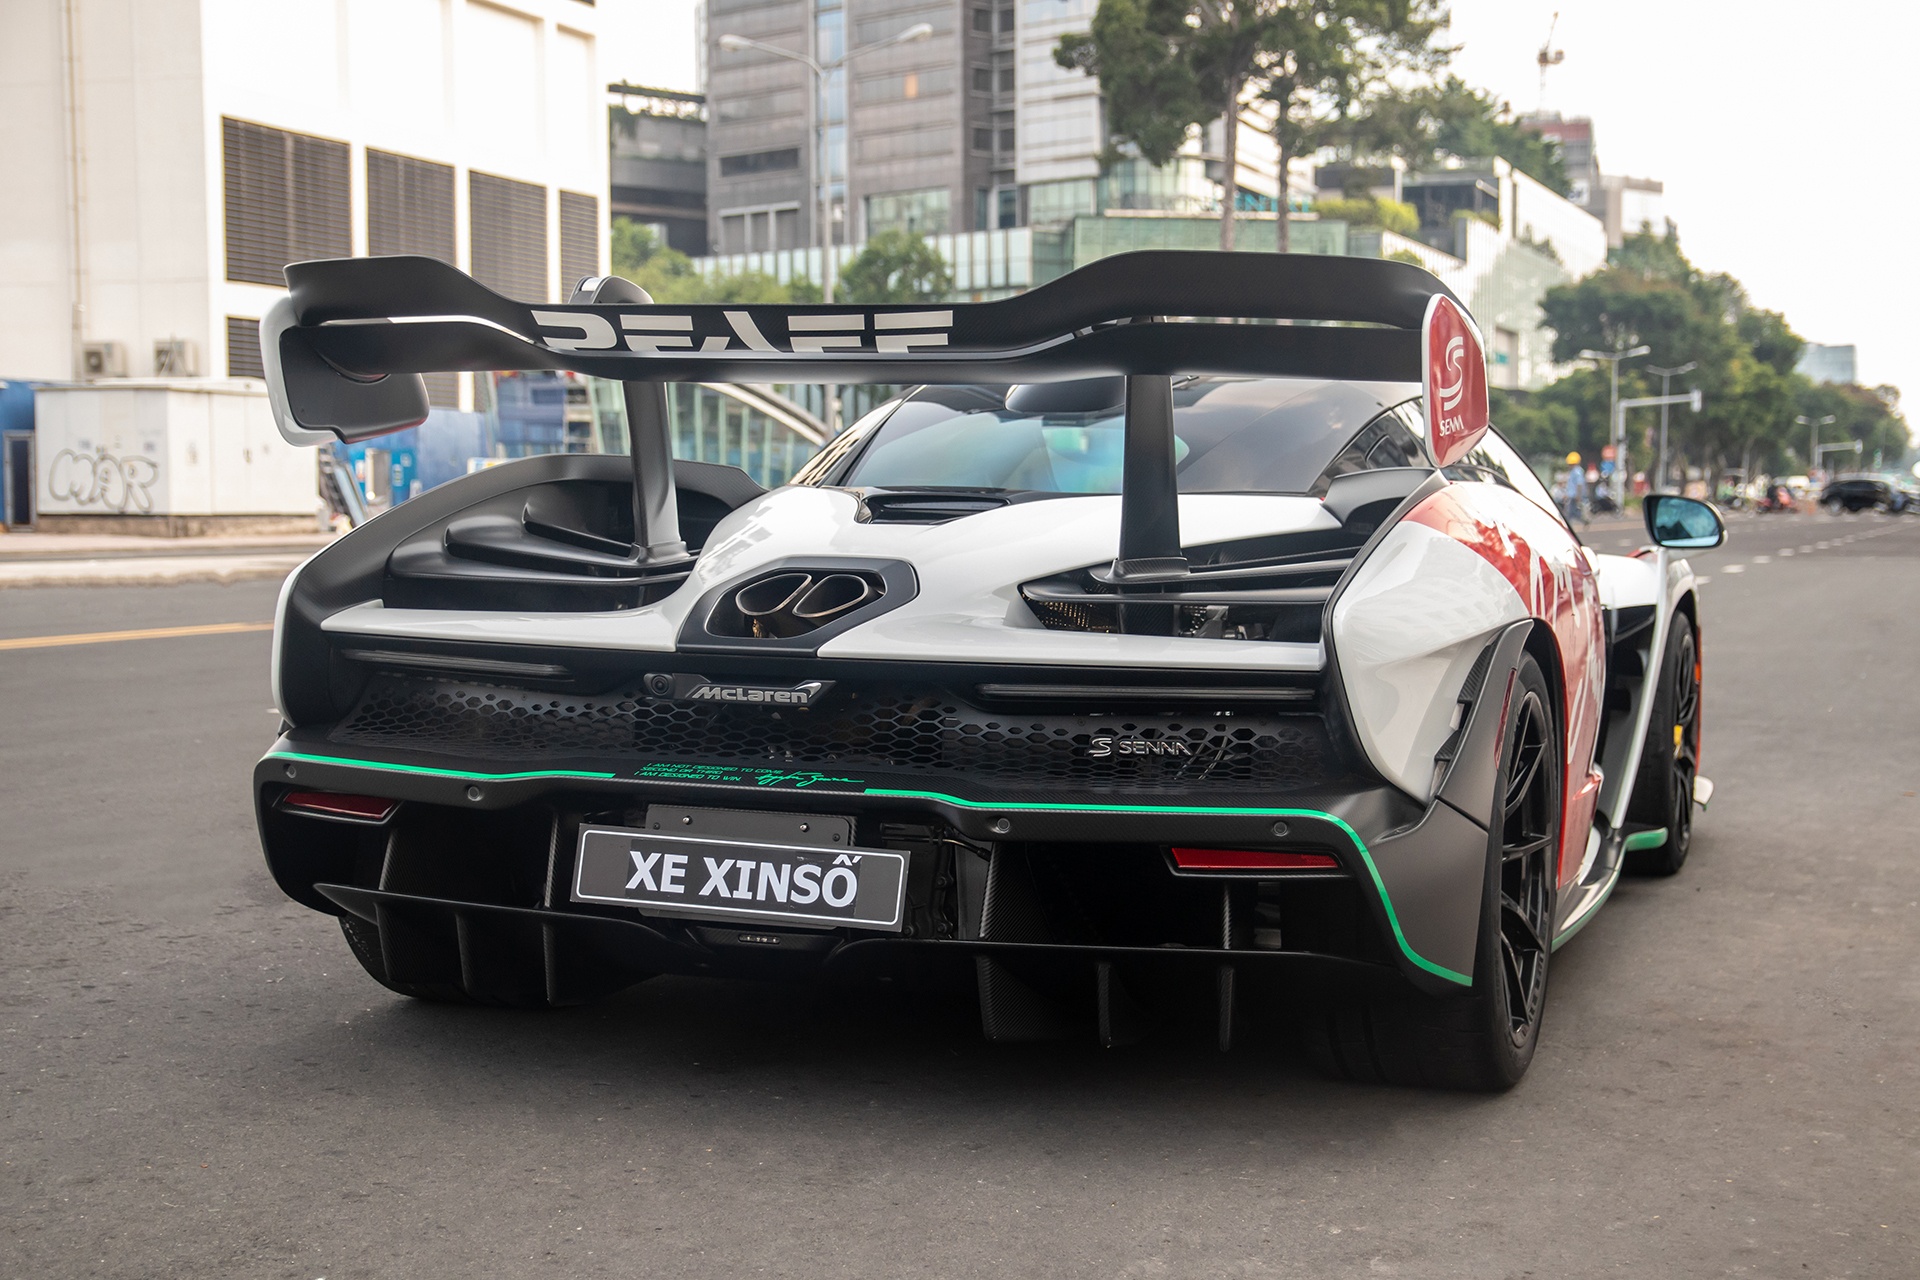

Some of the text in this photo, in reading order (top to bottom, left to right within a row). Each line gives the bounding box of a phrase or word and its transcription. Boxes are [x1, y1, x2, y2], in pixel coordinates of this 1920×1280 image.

[691, 686, 808, 704] McLaren
[1119, 740, 1193, 756] SENNA
[657, 771, 705, 779] DESIGNED
[625, 850, 863, 909] XE XINSỐ
